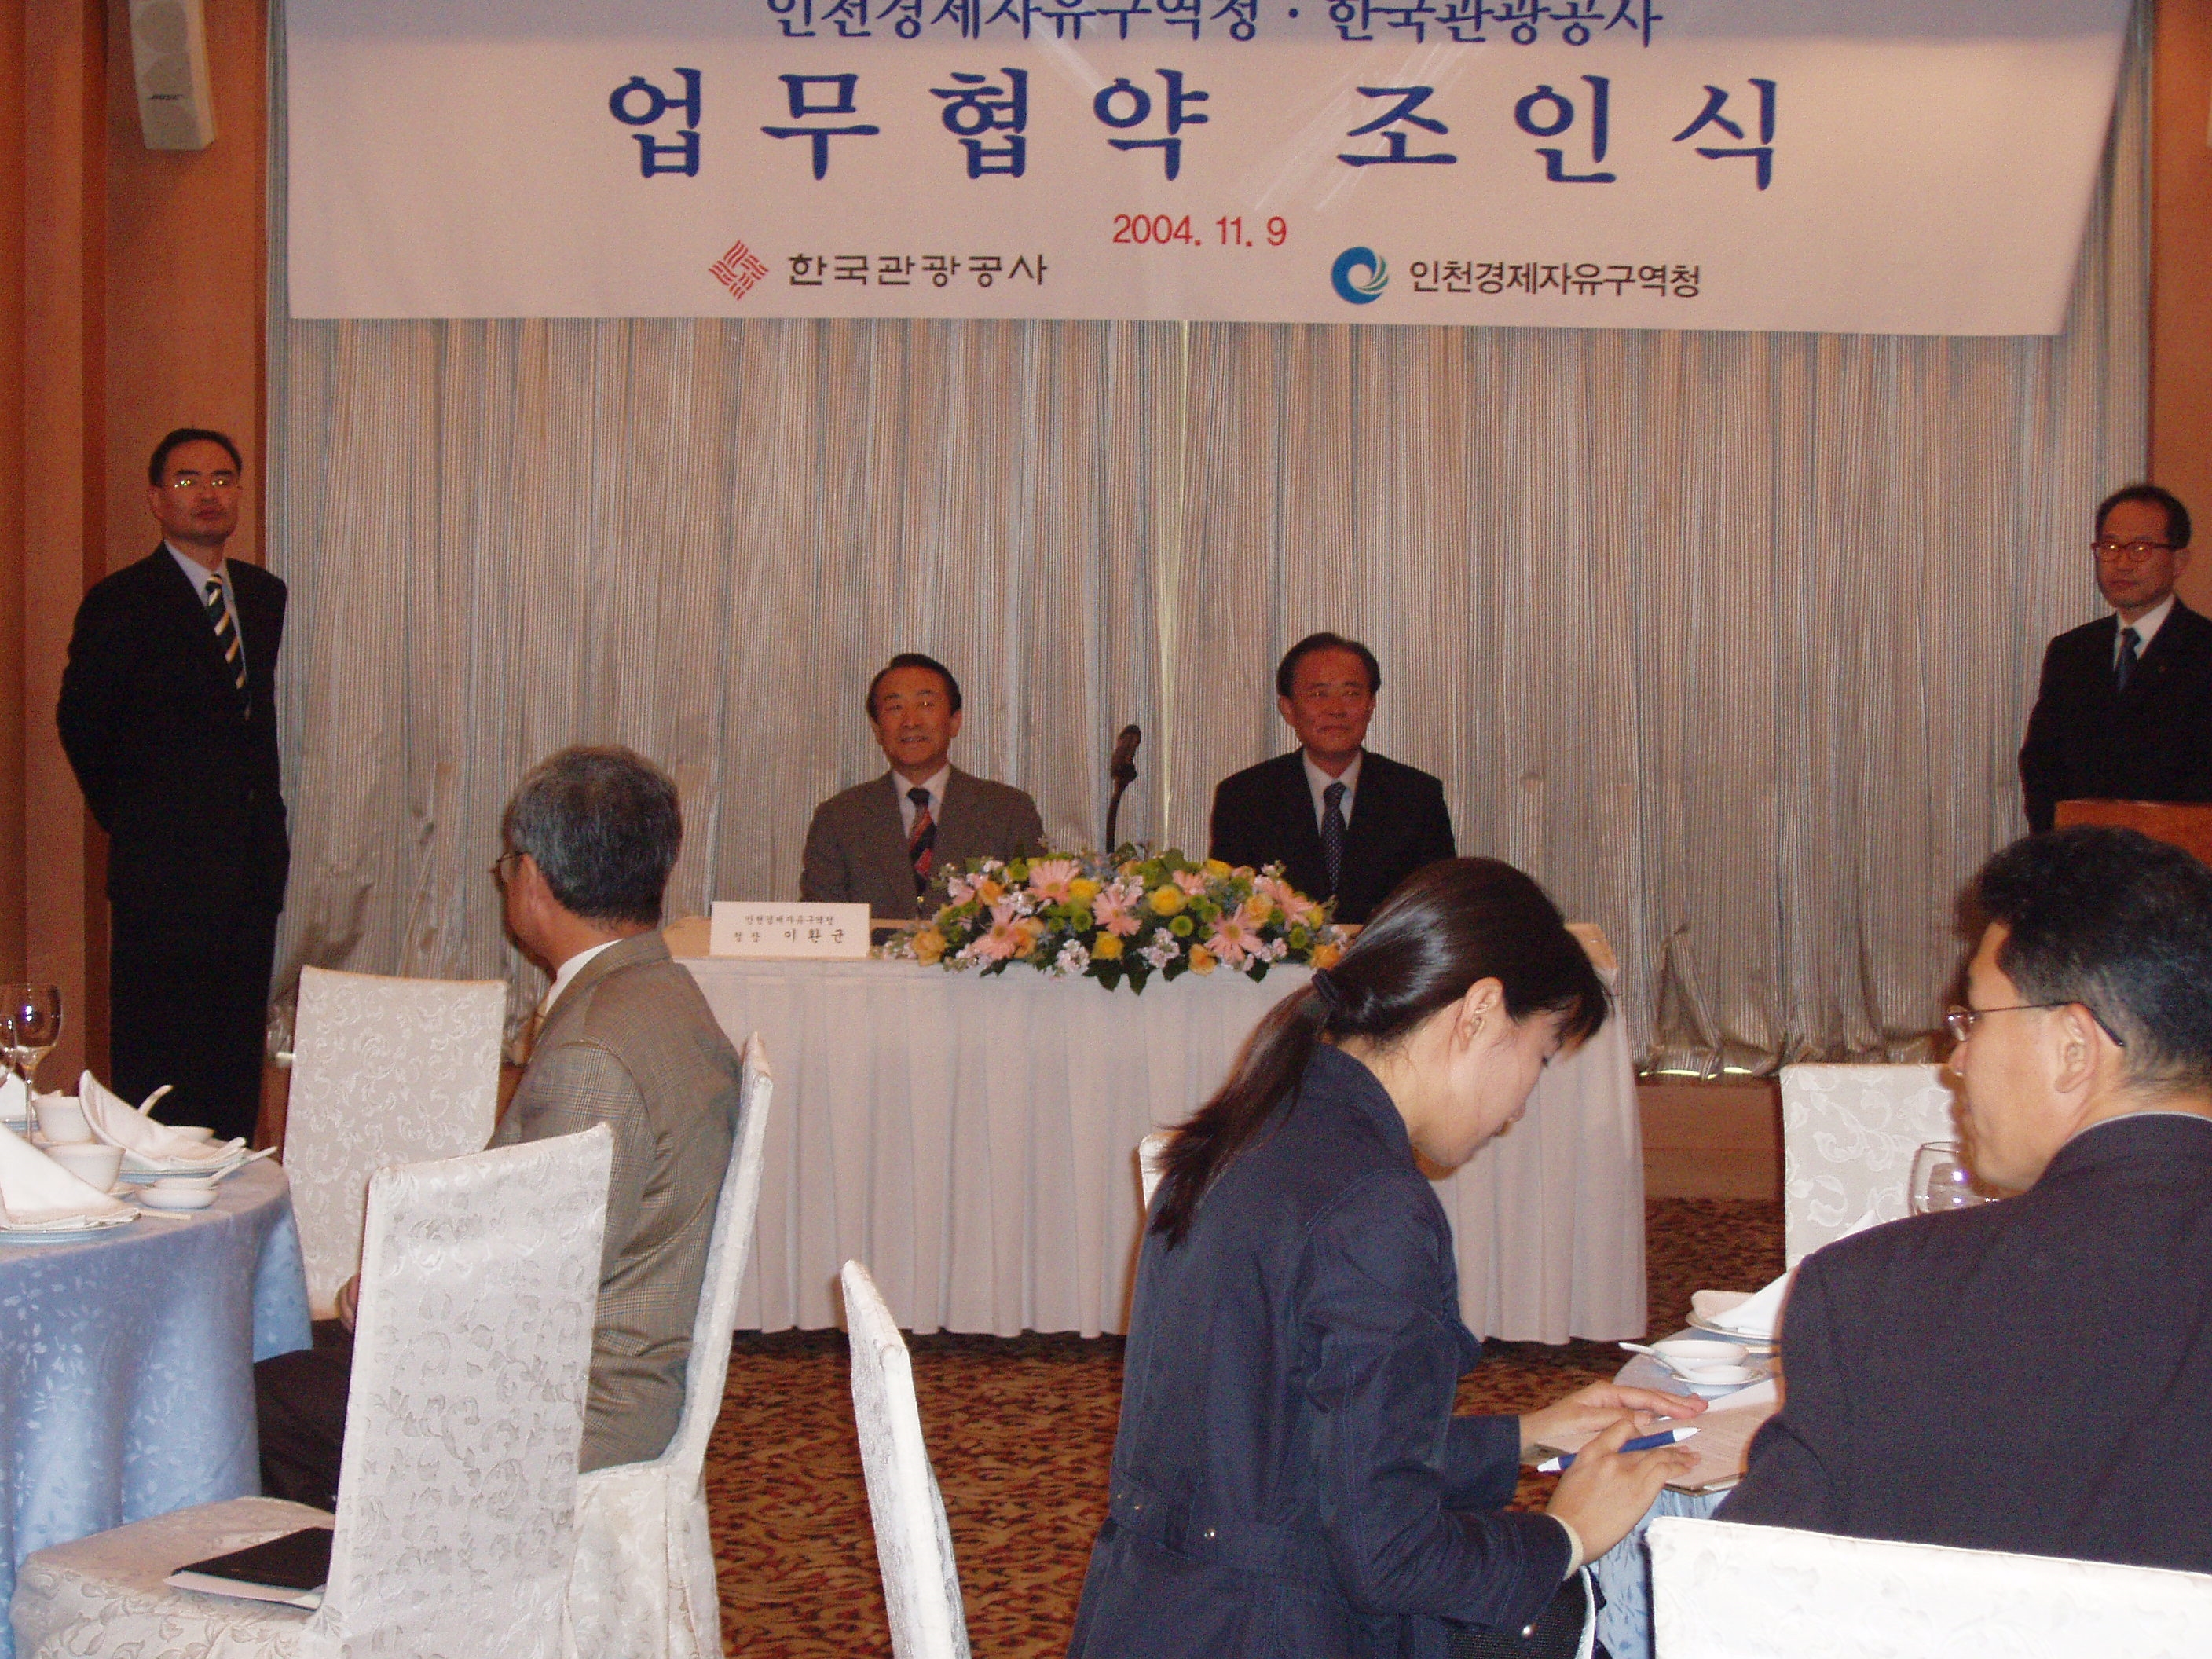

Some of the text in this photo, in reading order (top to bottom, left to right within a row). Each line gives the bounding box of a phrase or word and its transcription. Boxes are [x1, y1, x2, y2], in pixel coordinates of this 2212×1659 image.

[1328, 0, 1664, 48] 한국관광공사
[608, 67, 1777, 192] 업무협약 조인식
[1113, 214, 1288, 247] 2004. 11. 9
[787, 253, 1048, 288] 한국관광공사
[1409, 260, 1701, 298] 인천경제자유구역청
